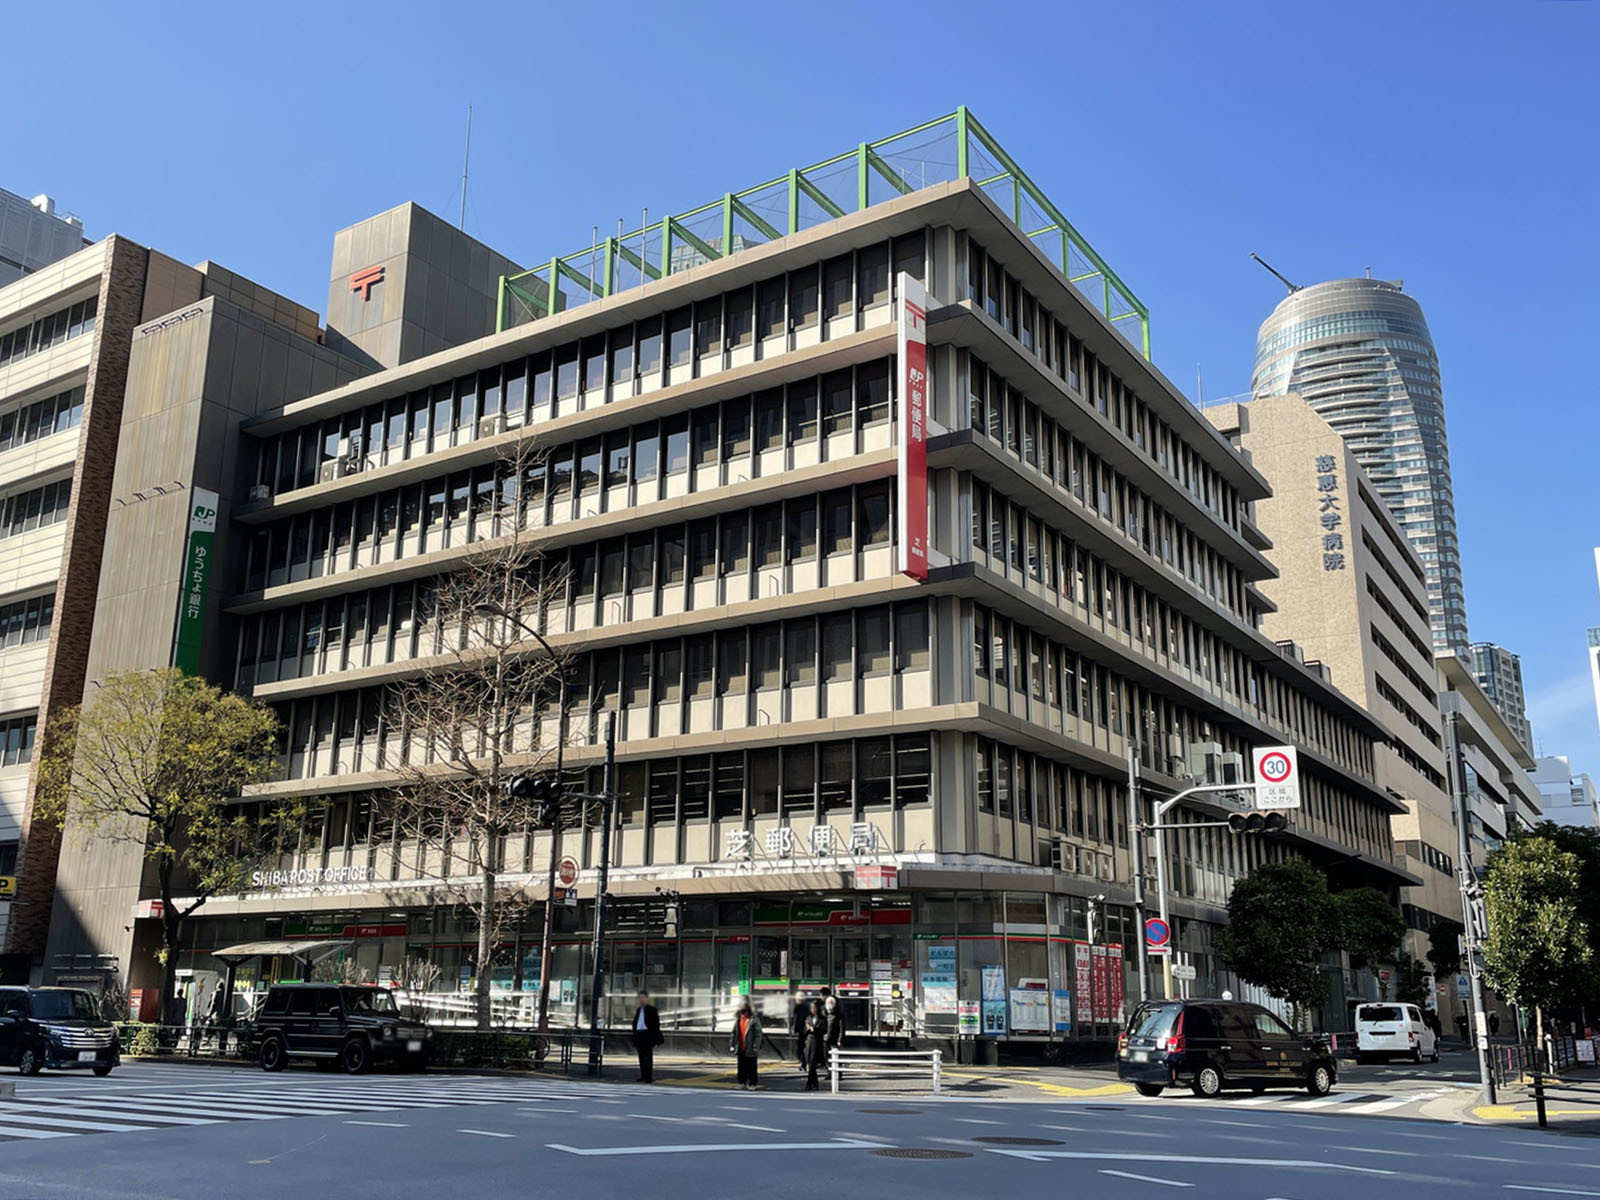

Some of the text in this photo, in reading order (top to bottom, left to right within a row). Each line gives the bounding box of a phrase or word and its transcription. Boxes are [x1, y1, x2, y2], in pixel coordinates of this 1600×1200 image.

[188, 546, 207, 619] ゆうちょ銀行
[1266, 759, 1286, 775] 30
[251, 864, 368, 887] SHIBA POST OFFICE
